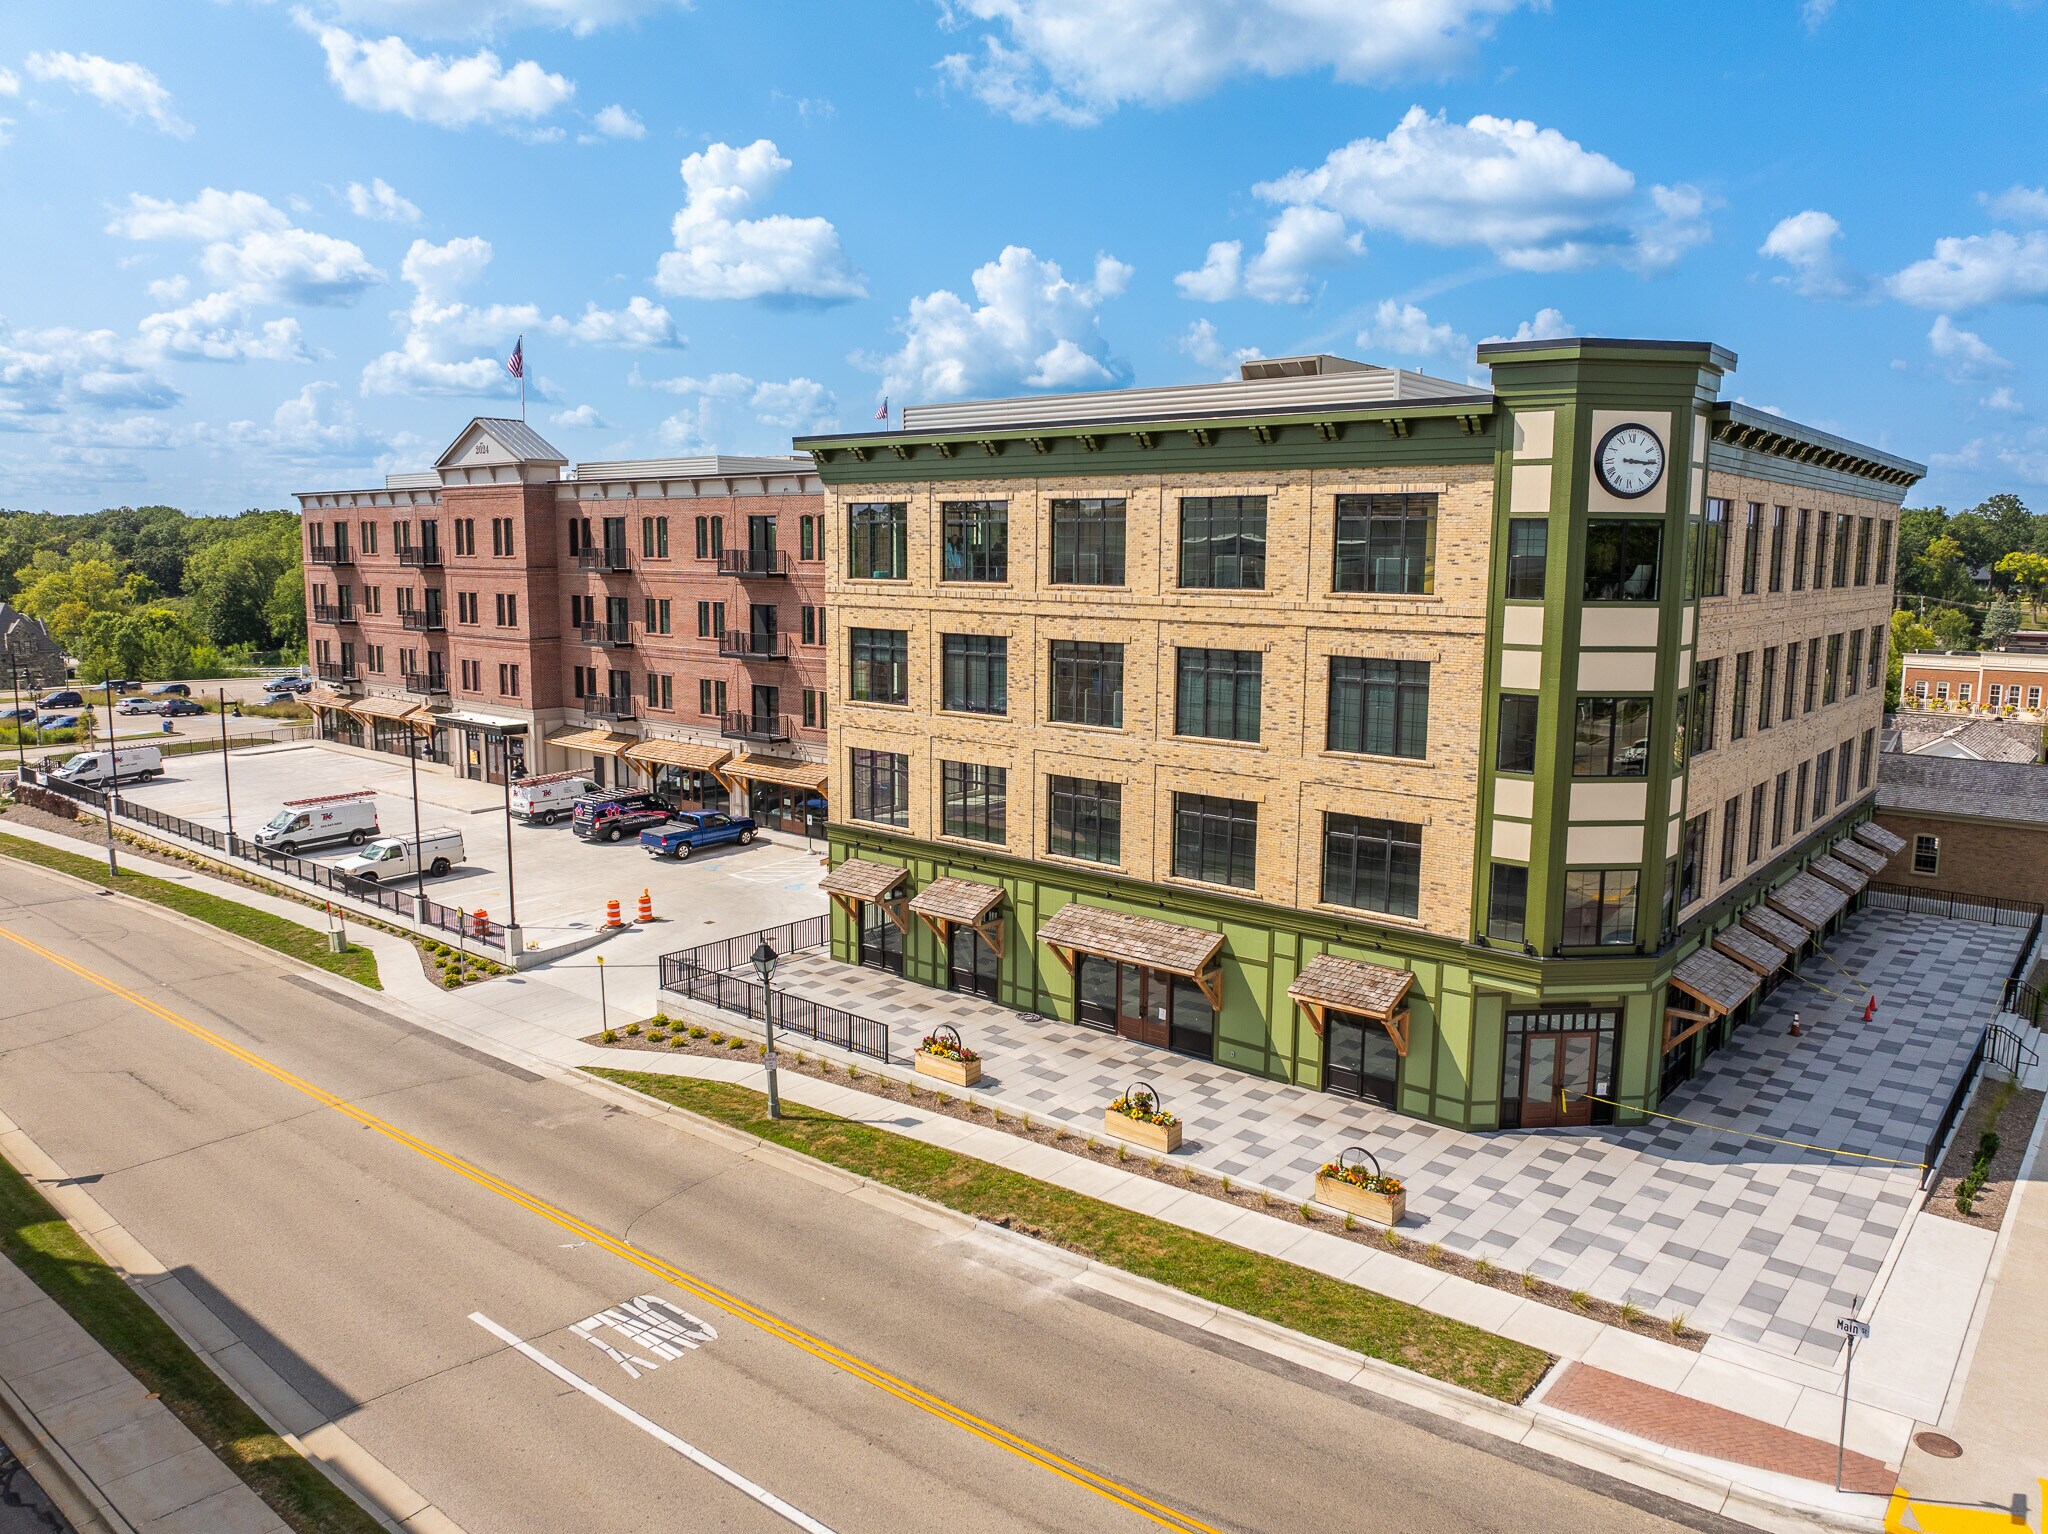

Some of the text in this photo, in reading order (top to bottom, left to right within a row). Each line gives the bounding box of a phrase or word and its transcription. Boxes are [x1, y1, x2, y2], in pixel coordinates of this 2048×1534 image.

[1628, 434, 1636, 443] XII
[476, 445, 489, 454] 2024
[1836, 1319, 1858, 1334] Main
[568, 1295, 718, 1380] ONLY
